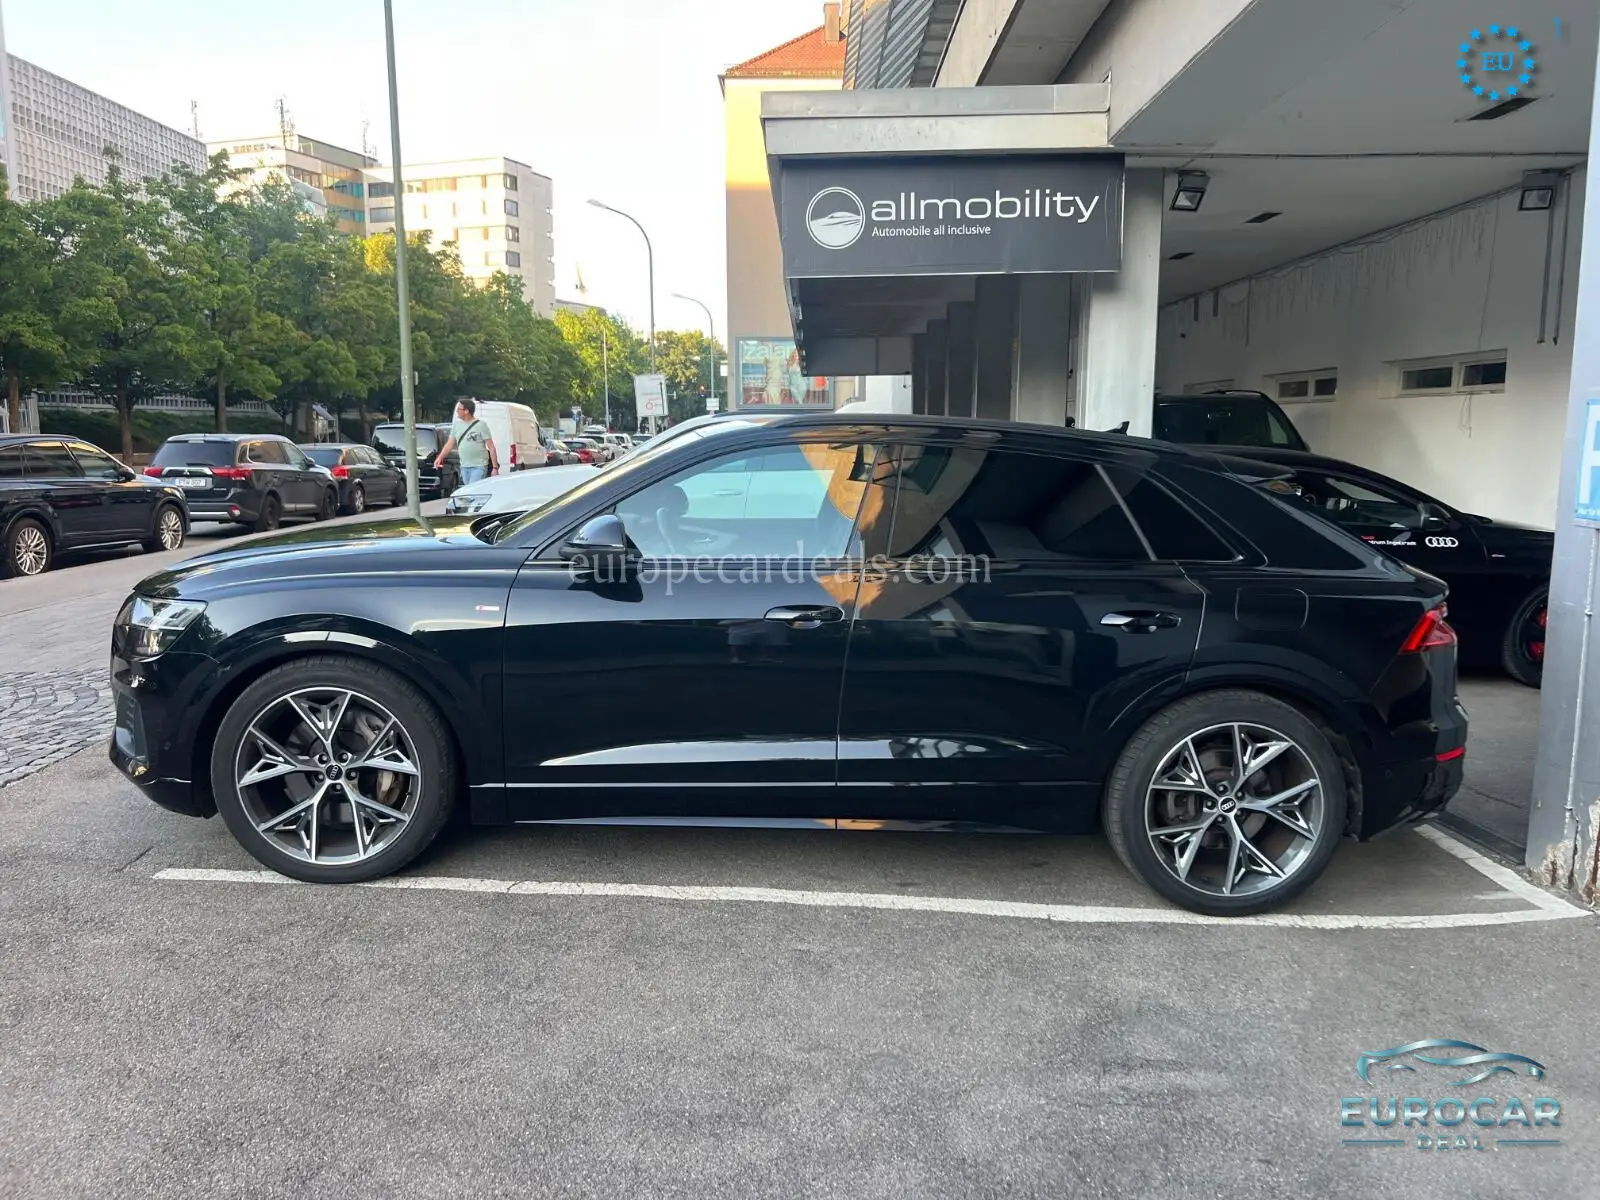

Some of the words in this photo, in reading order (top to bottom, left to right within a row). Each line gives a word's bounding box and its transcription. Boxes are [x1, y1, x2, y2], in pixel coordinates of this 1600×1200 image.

[871, 189, 1100, 223] allmobility
[872, 226, 931, 237] Automobile
[933, 225, 945, 236] all
[947, 225, 991, 235] inclusive
